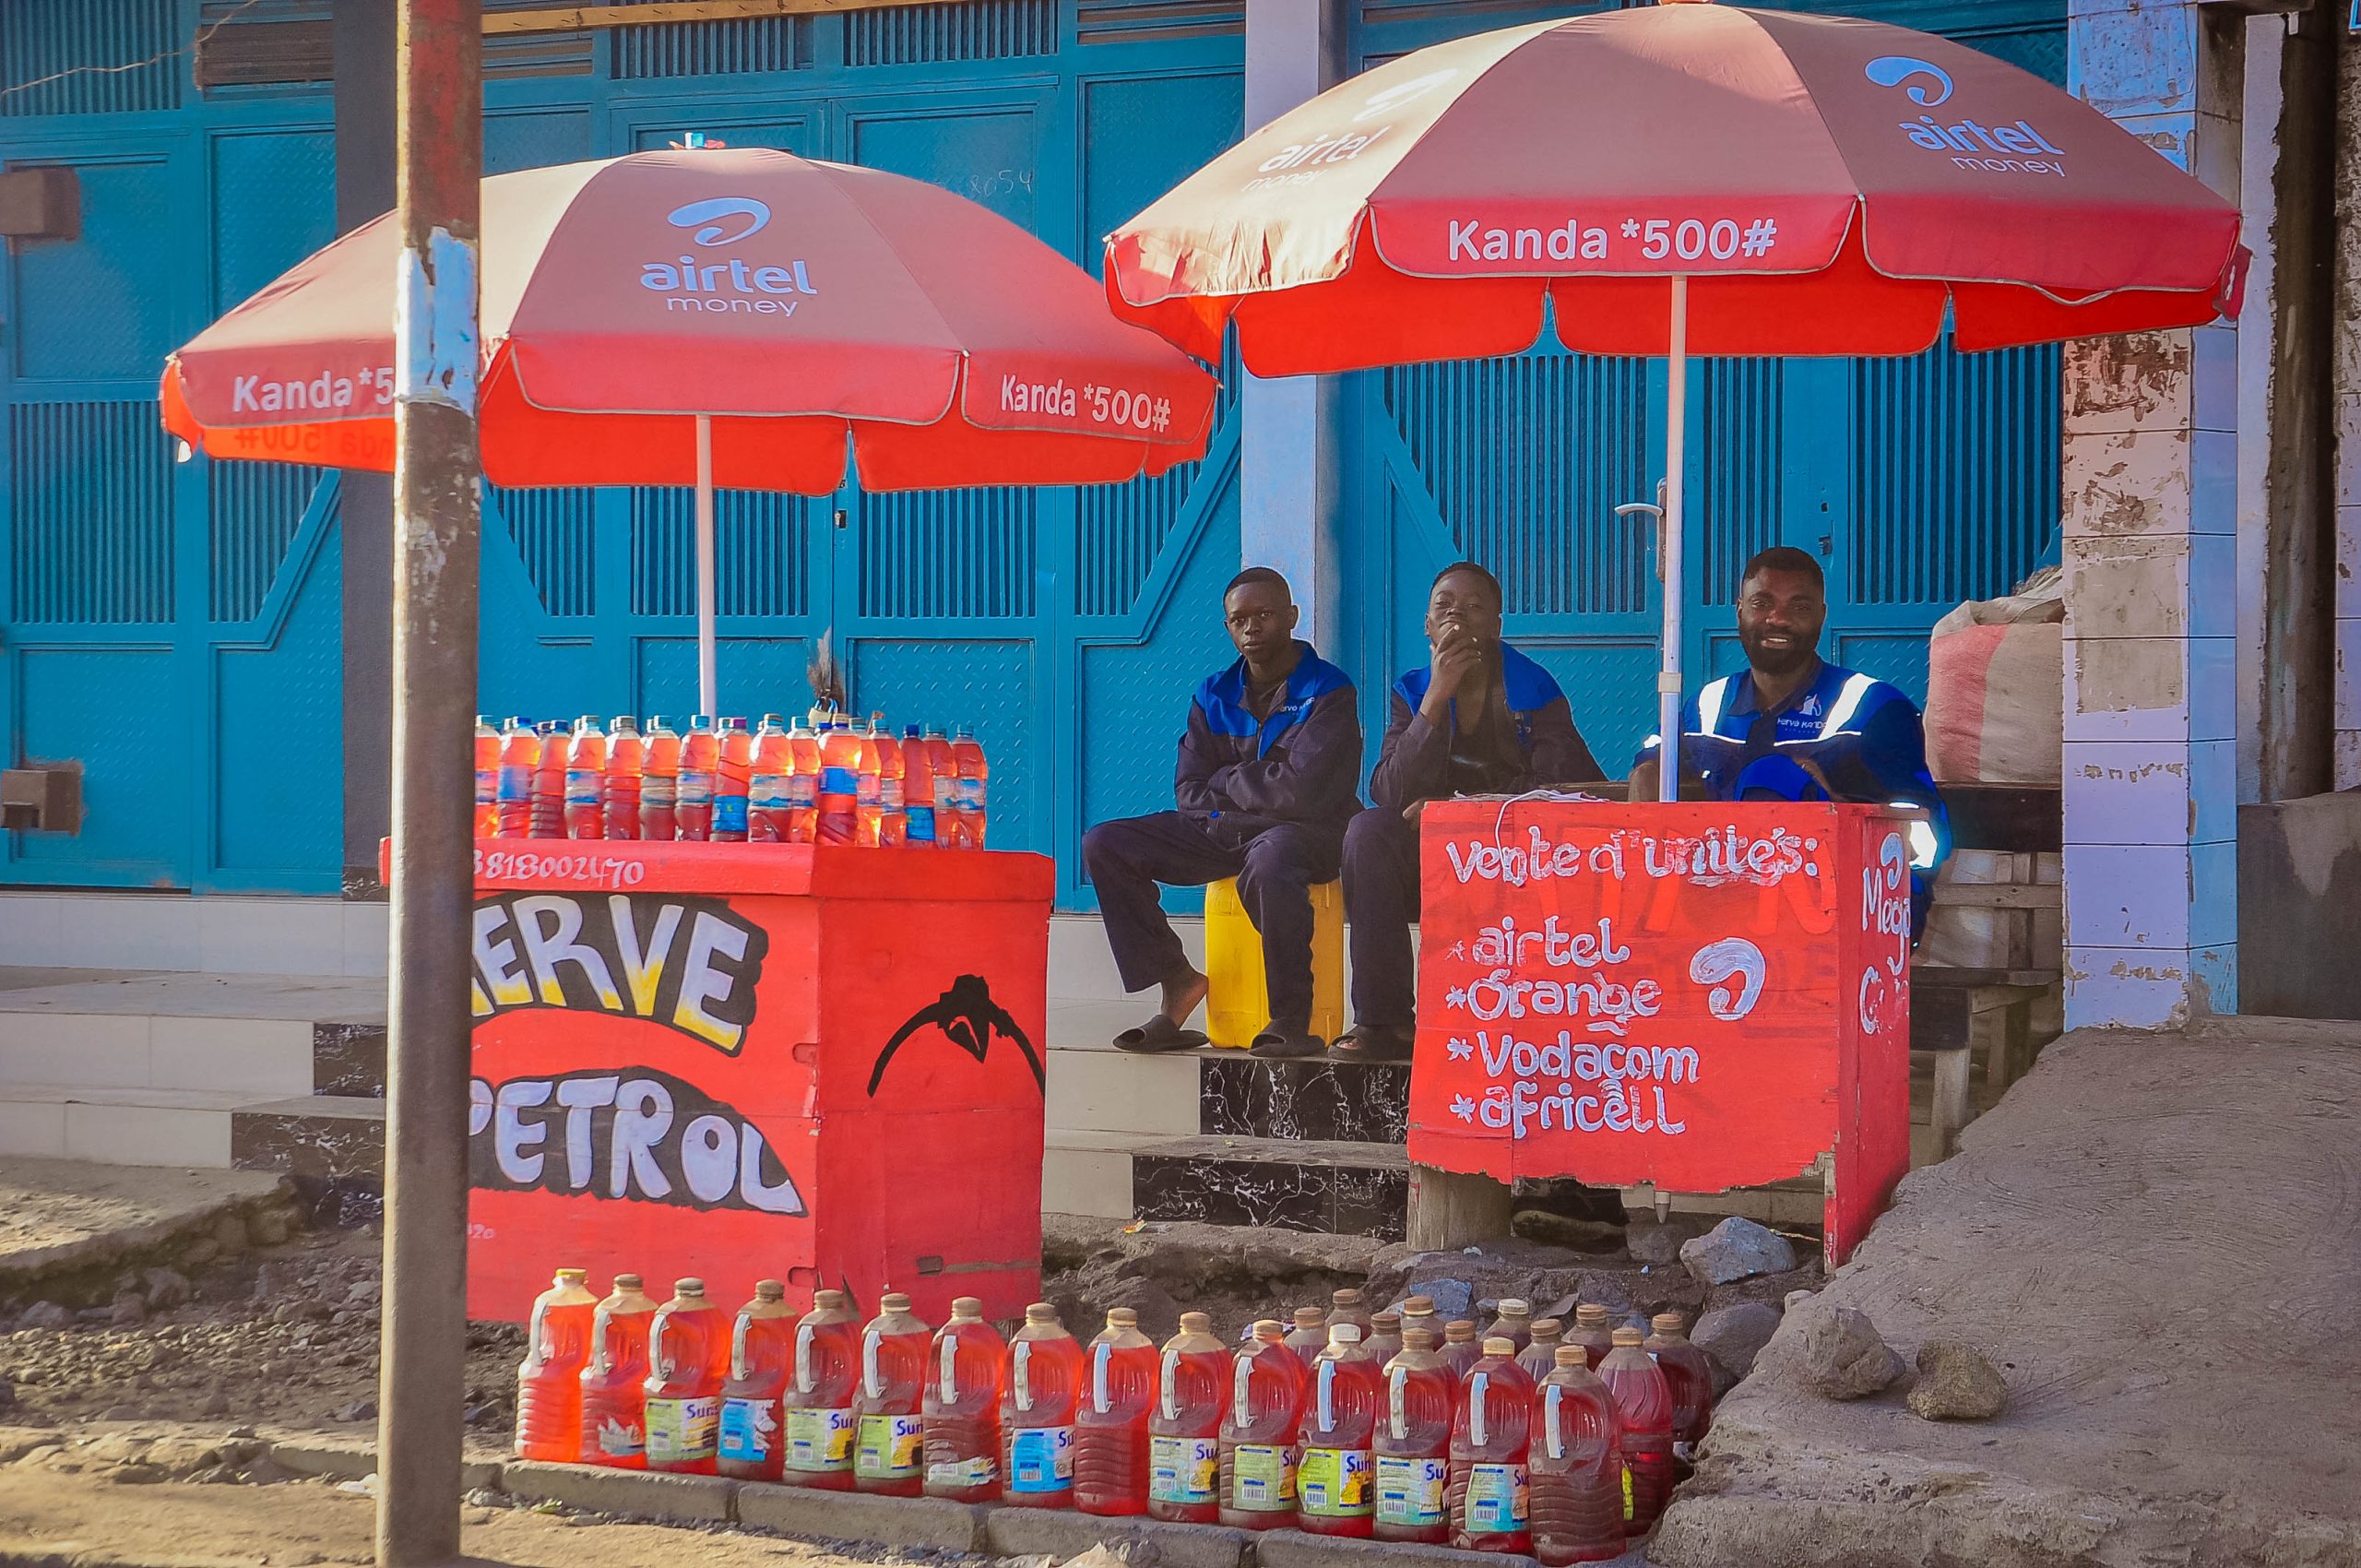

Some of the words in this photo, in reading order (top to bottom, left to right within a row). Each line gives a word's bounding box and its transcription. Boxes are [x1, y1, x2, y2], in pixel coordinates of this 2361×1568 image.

[1258, 125, 1392, 172] airtel
[1898, 114, 2066, 156] airtel
[1240, 169, 1329, 193] money
[1951, 156, 2067, 178] money
[1448, 218, 1608, 261] Kanda
[640, 255, 817, 295] airtel
[667, 296, 800, 317] money
[232, 370, 354, 413] Kanda
[1002, 374, 1076, 418] Kanda
